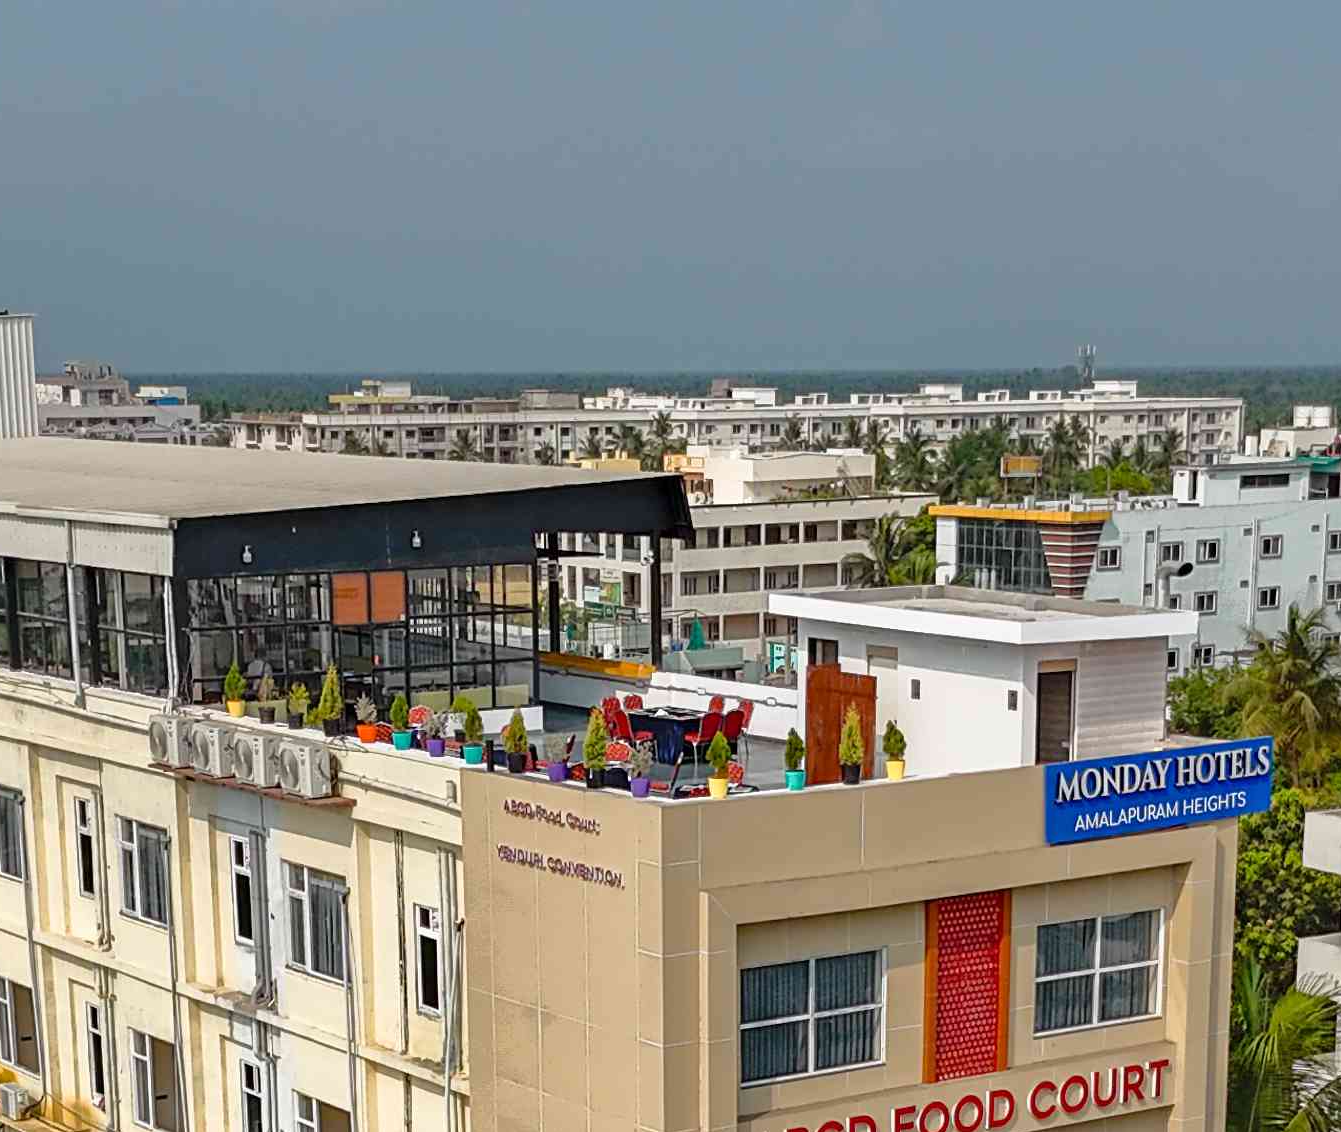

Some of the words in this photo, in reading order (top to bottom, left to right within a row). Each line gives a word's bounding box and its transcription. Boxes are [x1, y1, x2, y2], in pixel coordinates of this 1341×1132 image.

[1058, 757, 1171, 803] MONDAY
[1177, 745, 1270, 786] HOTELS
[1074, 801, 1179, 832] AMALAPURAM
[1183, 791, 1247, 816] HEIGHTS
[1026, 1059, 1170, 1121] COURT
